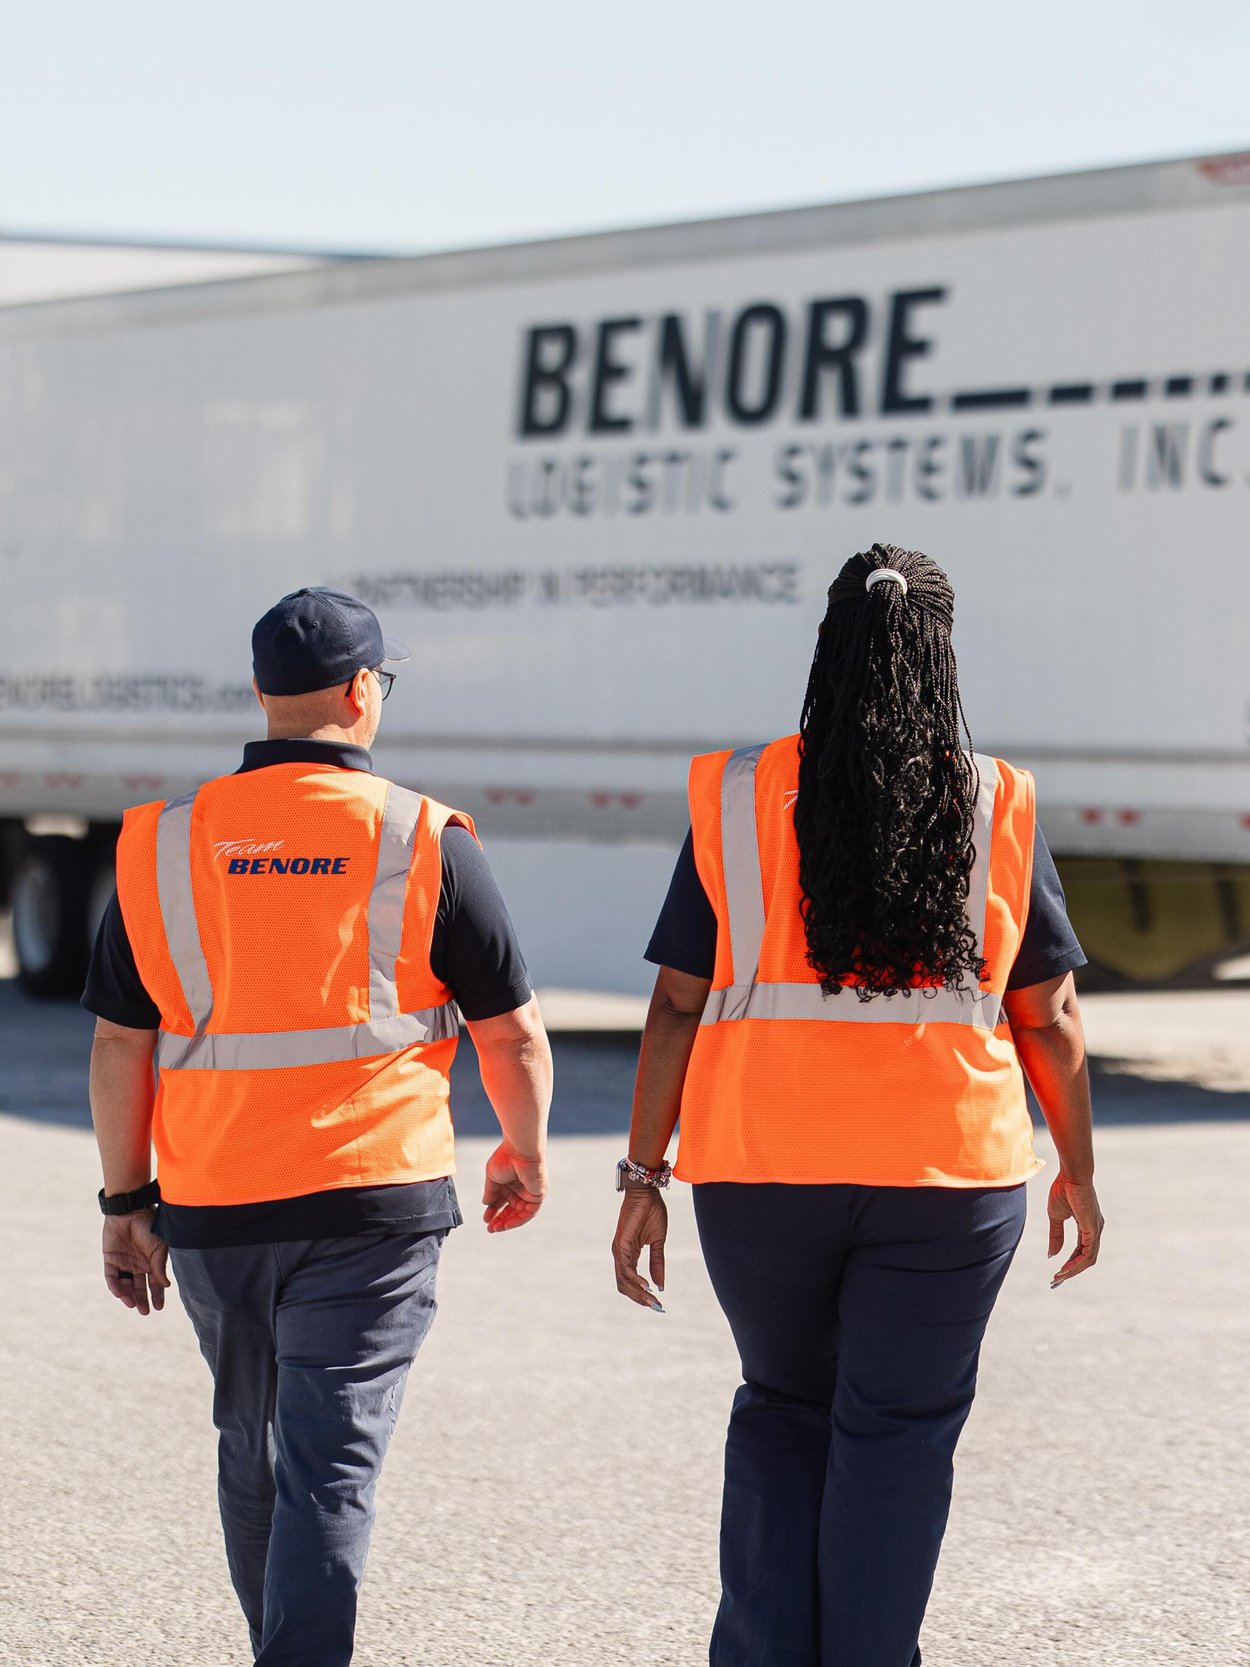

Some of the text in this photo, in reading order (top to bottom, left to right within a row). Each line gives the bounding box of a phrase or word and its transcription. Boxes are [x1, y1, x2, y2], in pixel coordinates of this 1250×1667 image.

[517, 286, 948, 442] BENORE
[508, 447, 739, 519] LOGISTIC
[213, 838, 285, 861] Team
[228, 857, 351, 875] BENORE
